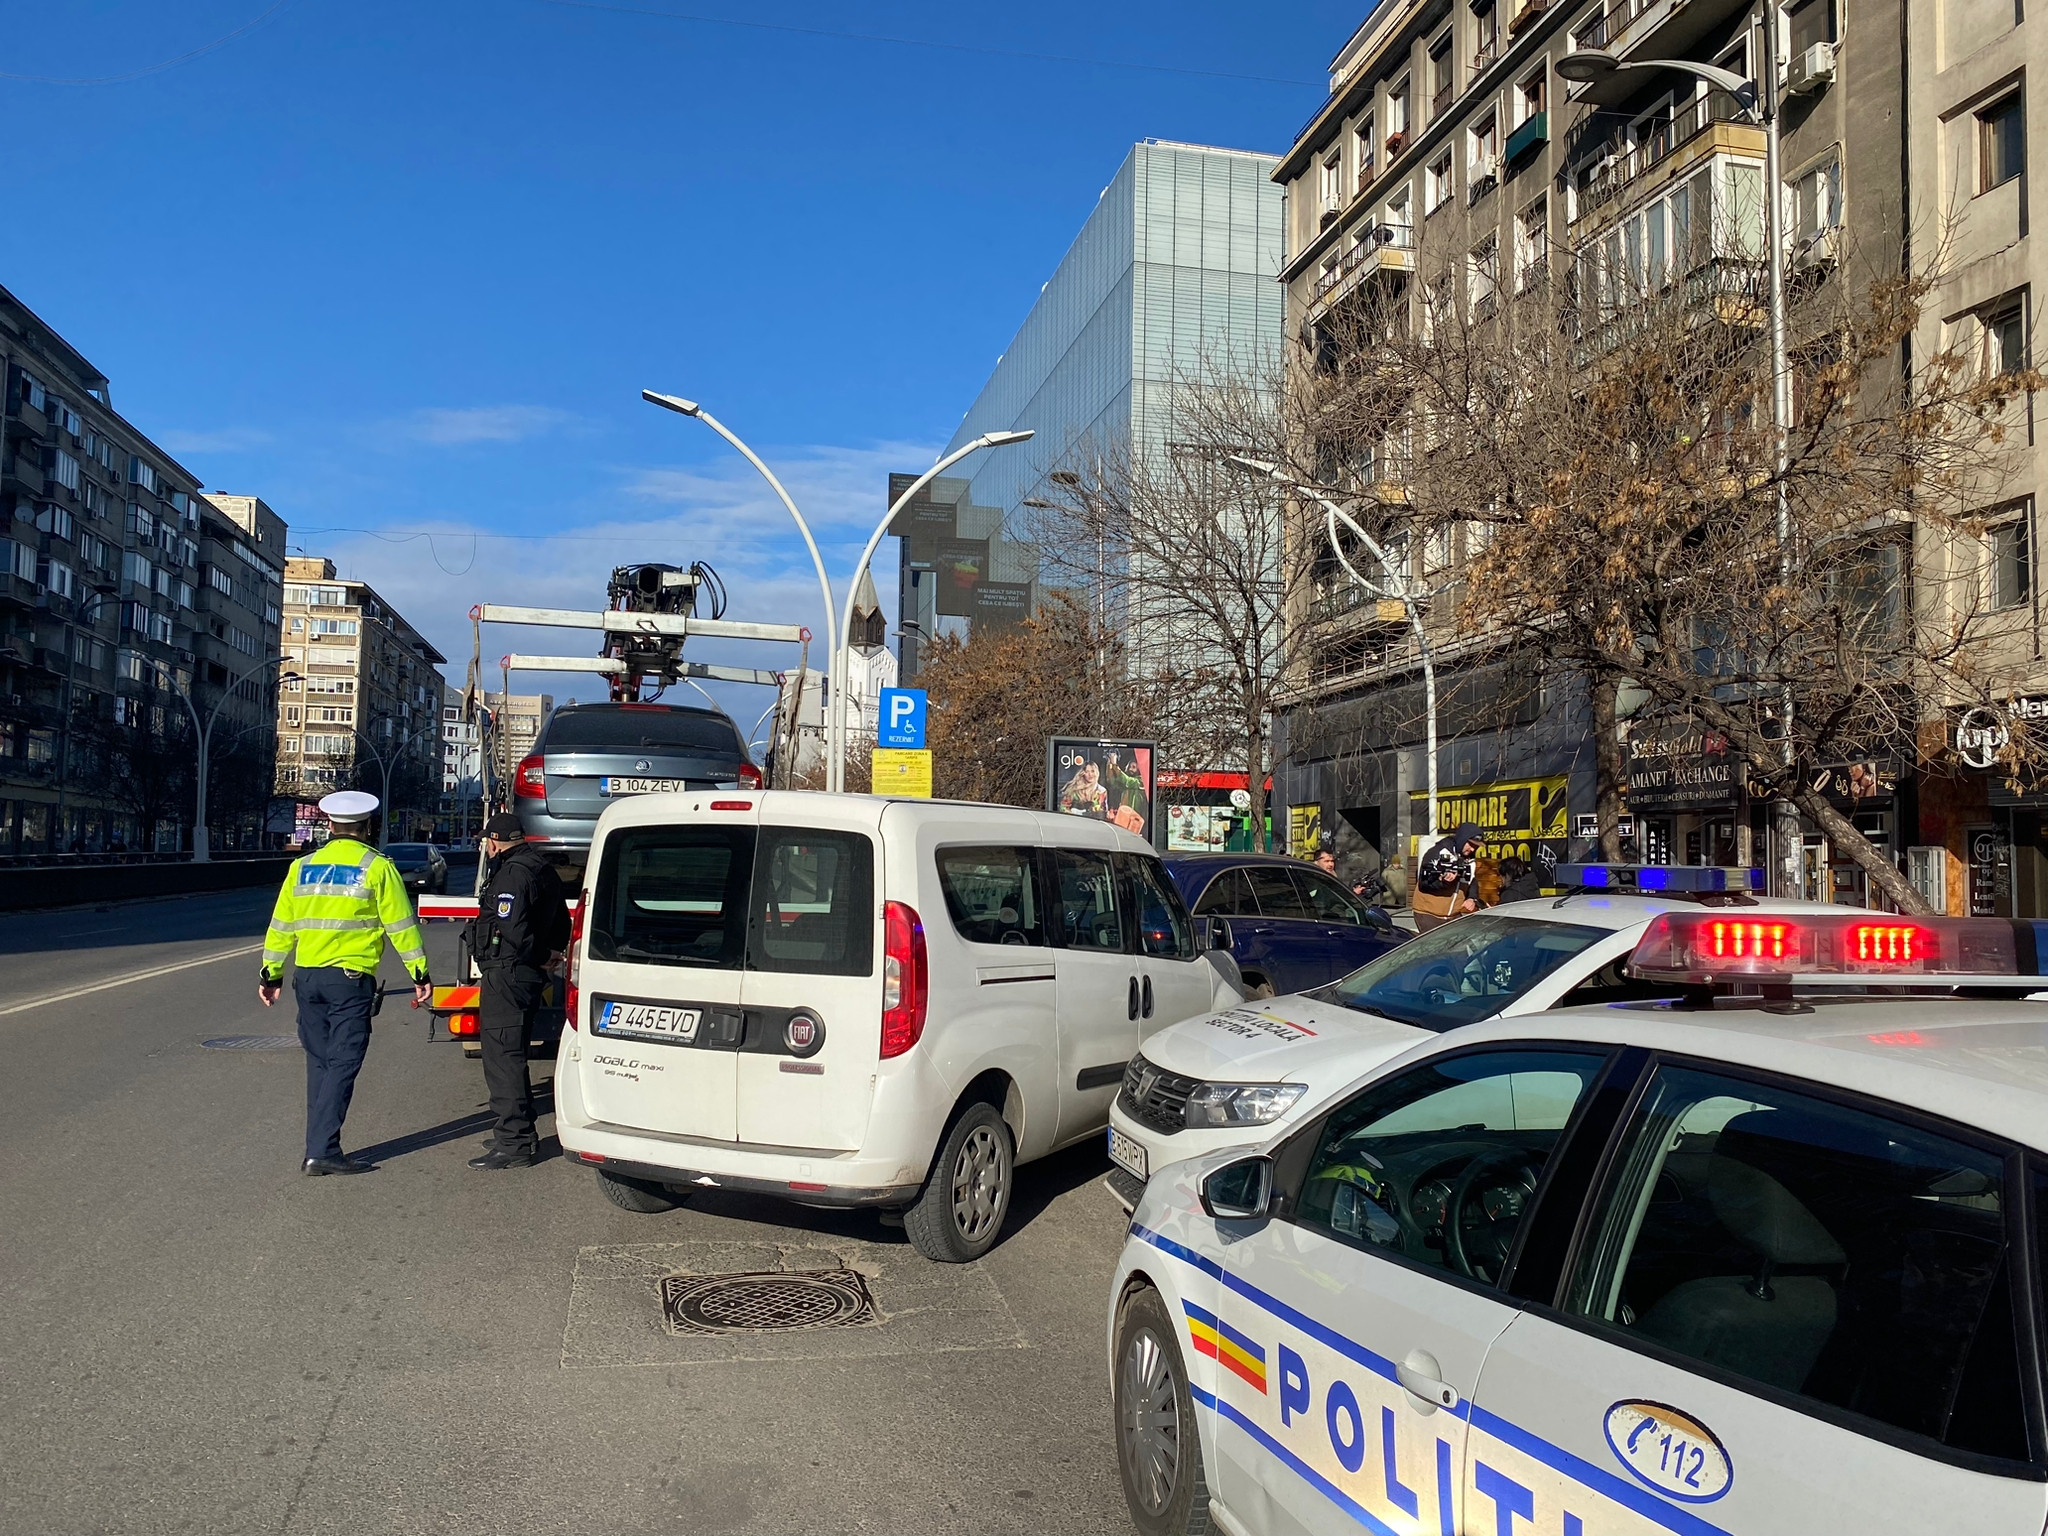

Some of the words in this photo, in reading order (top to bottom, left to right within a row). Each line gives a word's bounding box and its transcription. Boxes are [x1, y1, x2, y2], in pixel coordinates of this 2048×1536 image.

[890, 695, 915, 728] P
[1060, 749, 1084, 770] glo
[612, 780, 620, 790] B
[626, 780, 648, 792] 104
[651, 780, 680, 792] ZEV
[1630, 771, 1668, 789] AMANET
[1675, 765, 1730, 785] EXCHANGE
[1700, 788, 1730, 800] DIAMANTE
[1435, 795, 1508, 830] ICHIDARE
[609, 1006, 622, 1024] B
[794, 1026, 810, 1040] FIAT
[1206, 1019, 1252, 1035] SECTOR
[594, 1055, 640, 1068] DOBLO
[1660, 1433, 1704, 1488] 112
